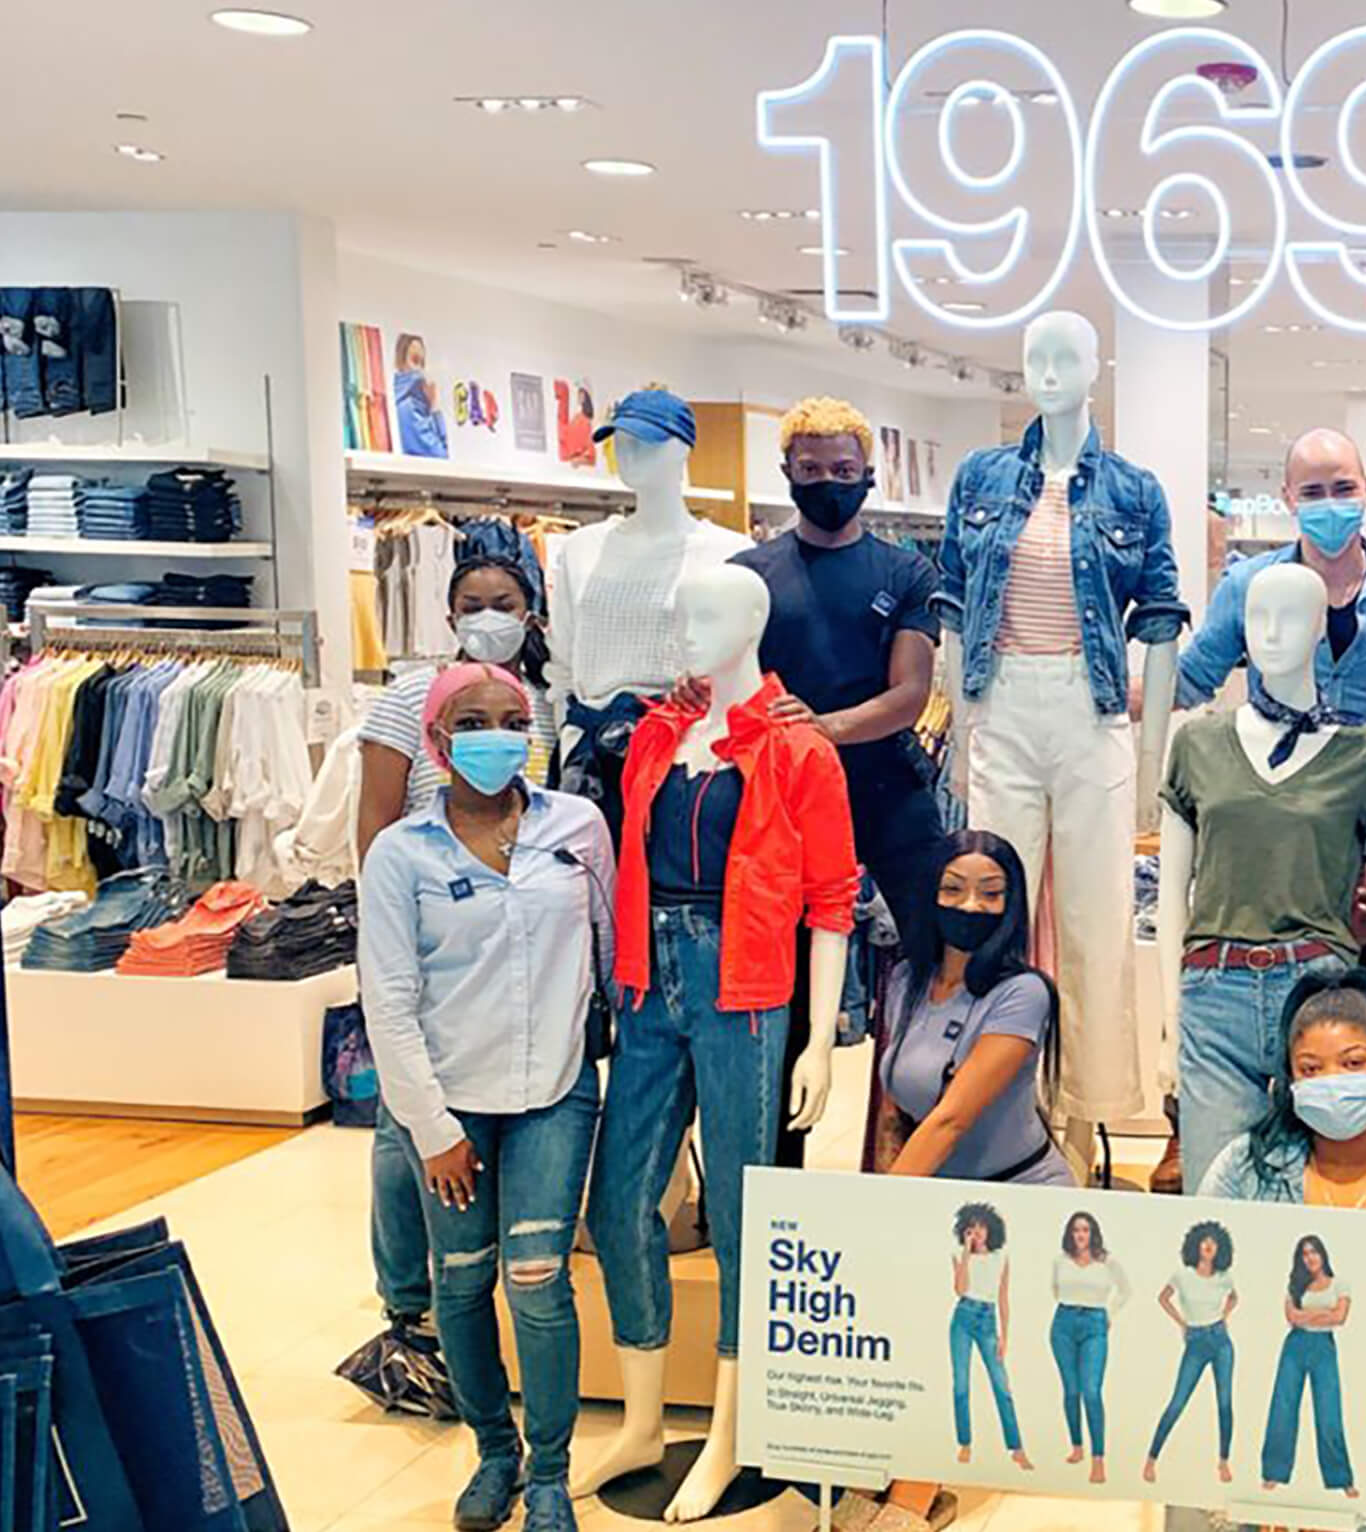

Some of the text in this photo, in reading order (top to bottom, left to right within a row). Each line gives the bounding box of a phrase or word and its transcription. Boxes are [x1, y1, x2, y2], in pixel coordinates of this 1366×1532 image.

[770, 1220, 798, 1231] NEW
[769, 1238, 842, 1282] Sky
[769, 1279, 856, 1323] High
[768, 1319, 892, 1361] Denim
[767, 1369, 785, 1380] Our
[788, 1372, 822, 1384] highest
[847, 1377, 869, 1387] Your
[872, 1378, 906, 1390] favorite
[826, 1406, 844, 1416] and
